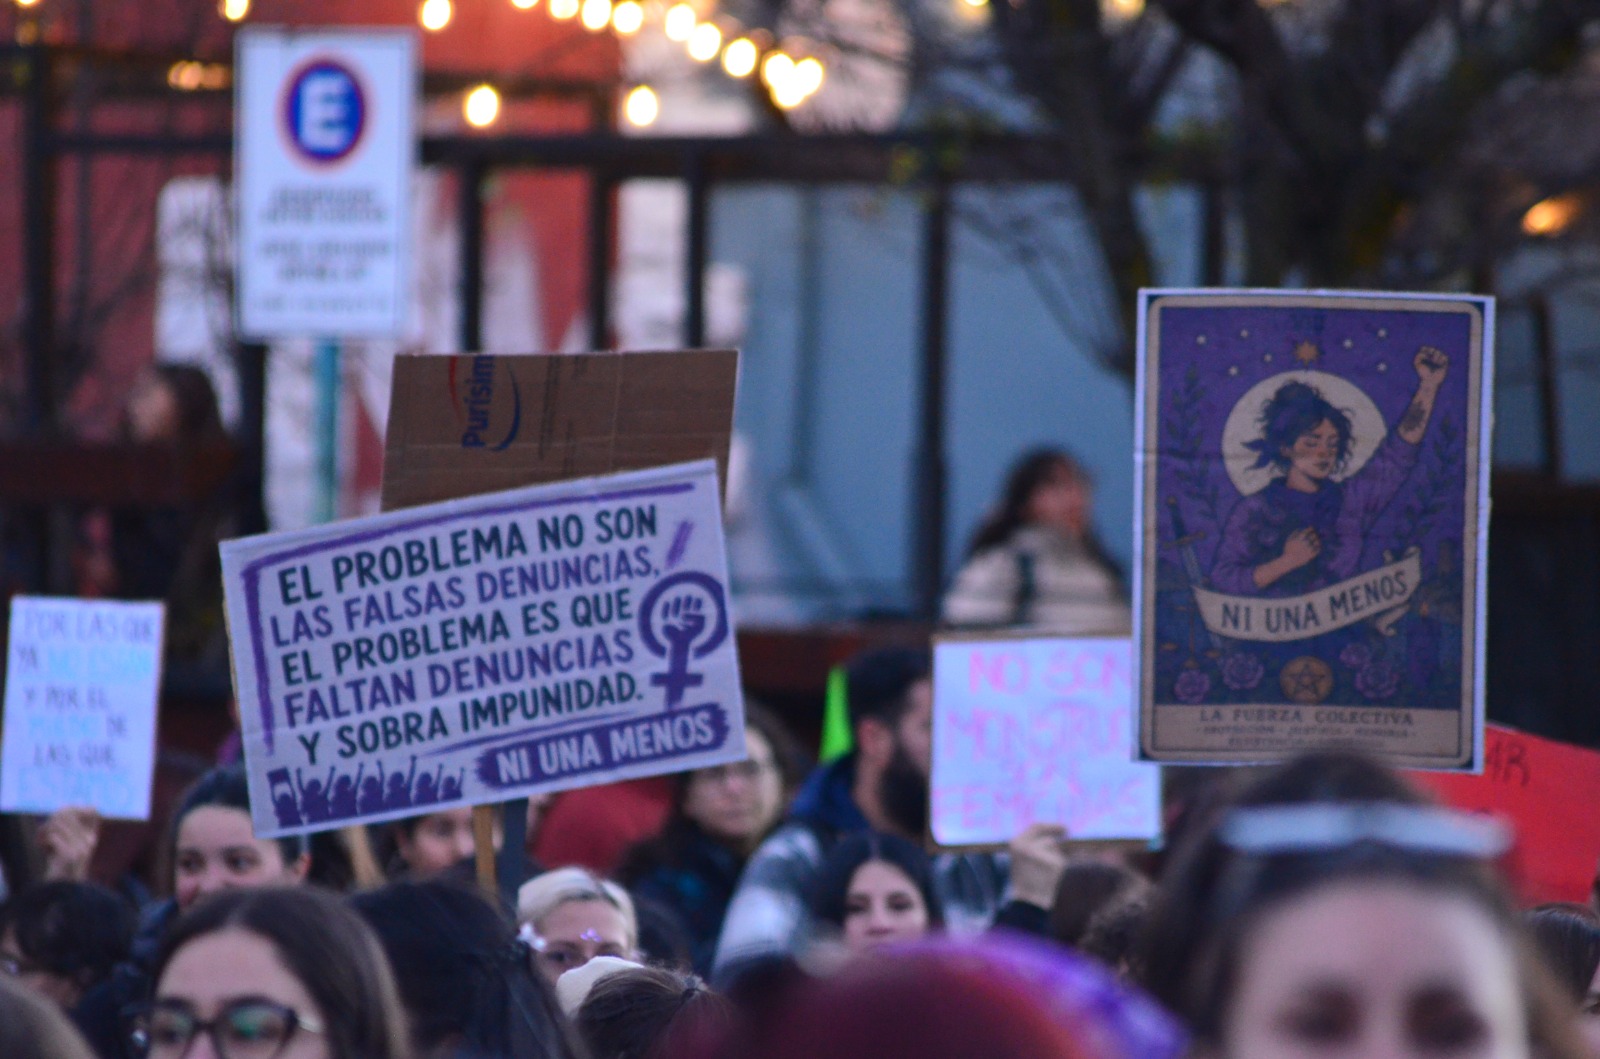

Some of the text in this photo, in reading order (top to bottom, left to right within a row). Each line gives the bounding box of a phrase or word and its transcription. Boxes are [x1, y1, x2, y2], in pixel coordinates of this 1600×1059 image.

[301, 77, 345, 147] E
[270, 545, 660, 648] LAS FALSAS DENUNCIAS,
[278, 504, 657, 606] EL PROBLEMA NO SON
[281, 587, 633, 687] EL PROBLEMA ES QUE
[1221, 571, 1409, 633] NI UNA MENOS
[283, 629, 634, 729] FALTAN DENUNCIAS
[968, 650, 1031, 696] NO
[298, 671, 644, 766] Y SOBRA IMPUNIDAD.
[496, 710, 716, 784] NI UNA MENOS
[1200, 709, 1414, 726] LA FUERZA COLECTIVA
